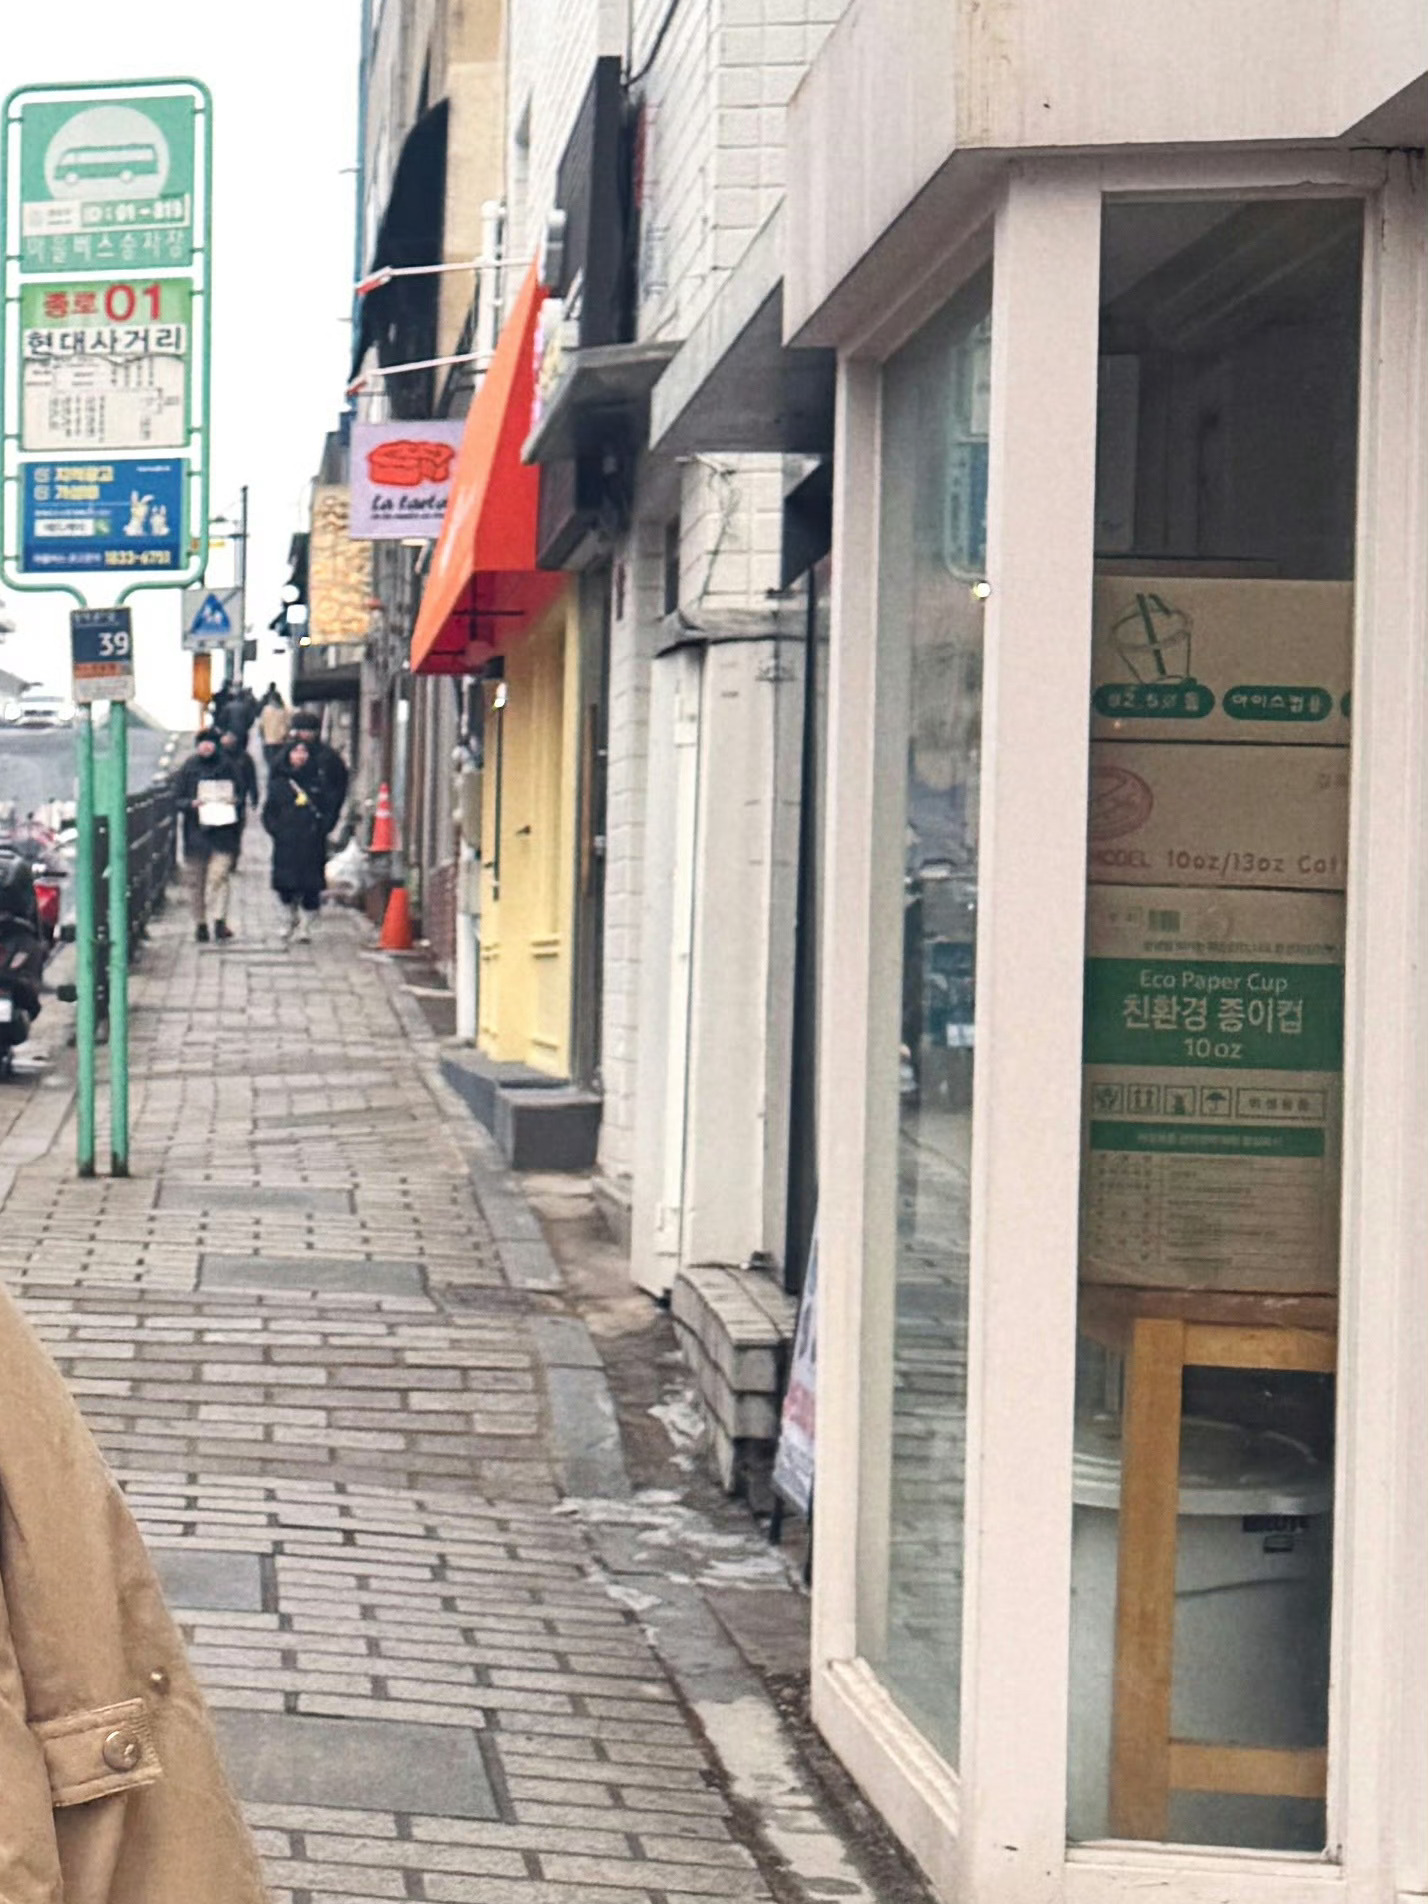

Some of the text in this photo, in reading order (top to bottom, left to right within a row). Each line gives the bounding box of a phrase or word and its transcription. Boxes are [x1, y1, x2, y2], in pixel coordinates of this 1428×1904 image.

[44, 283, 162, 322] 종로 01
[28, 326, 182, 356] 현대사거리
[97, 631, 130, 656] 39
[1140, 969, 1288, 995] Eco Paper Cup
[1123, 995, 1303, 1034] 친환경 종이컵
